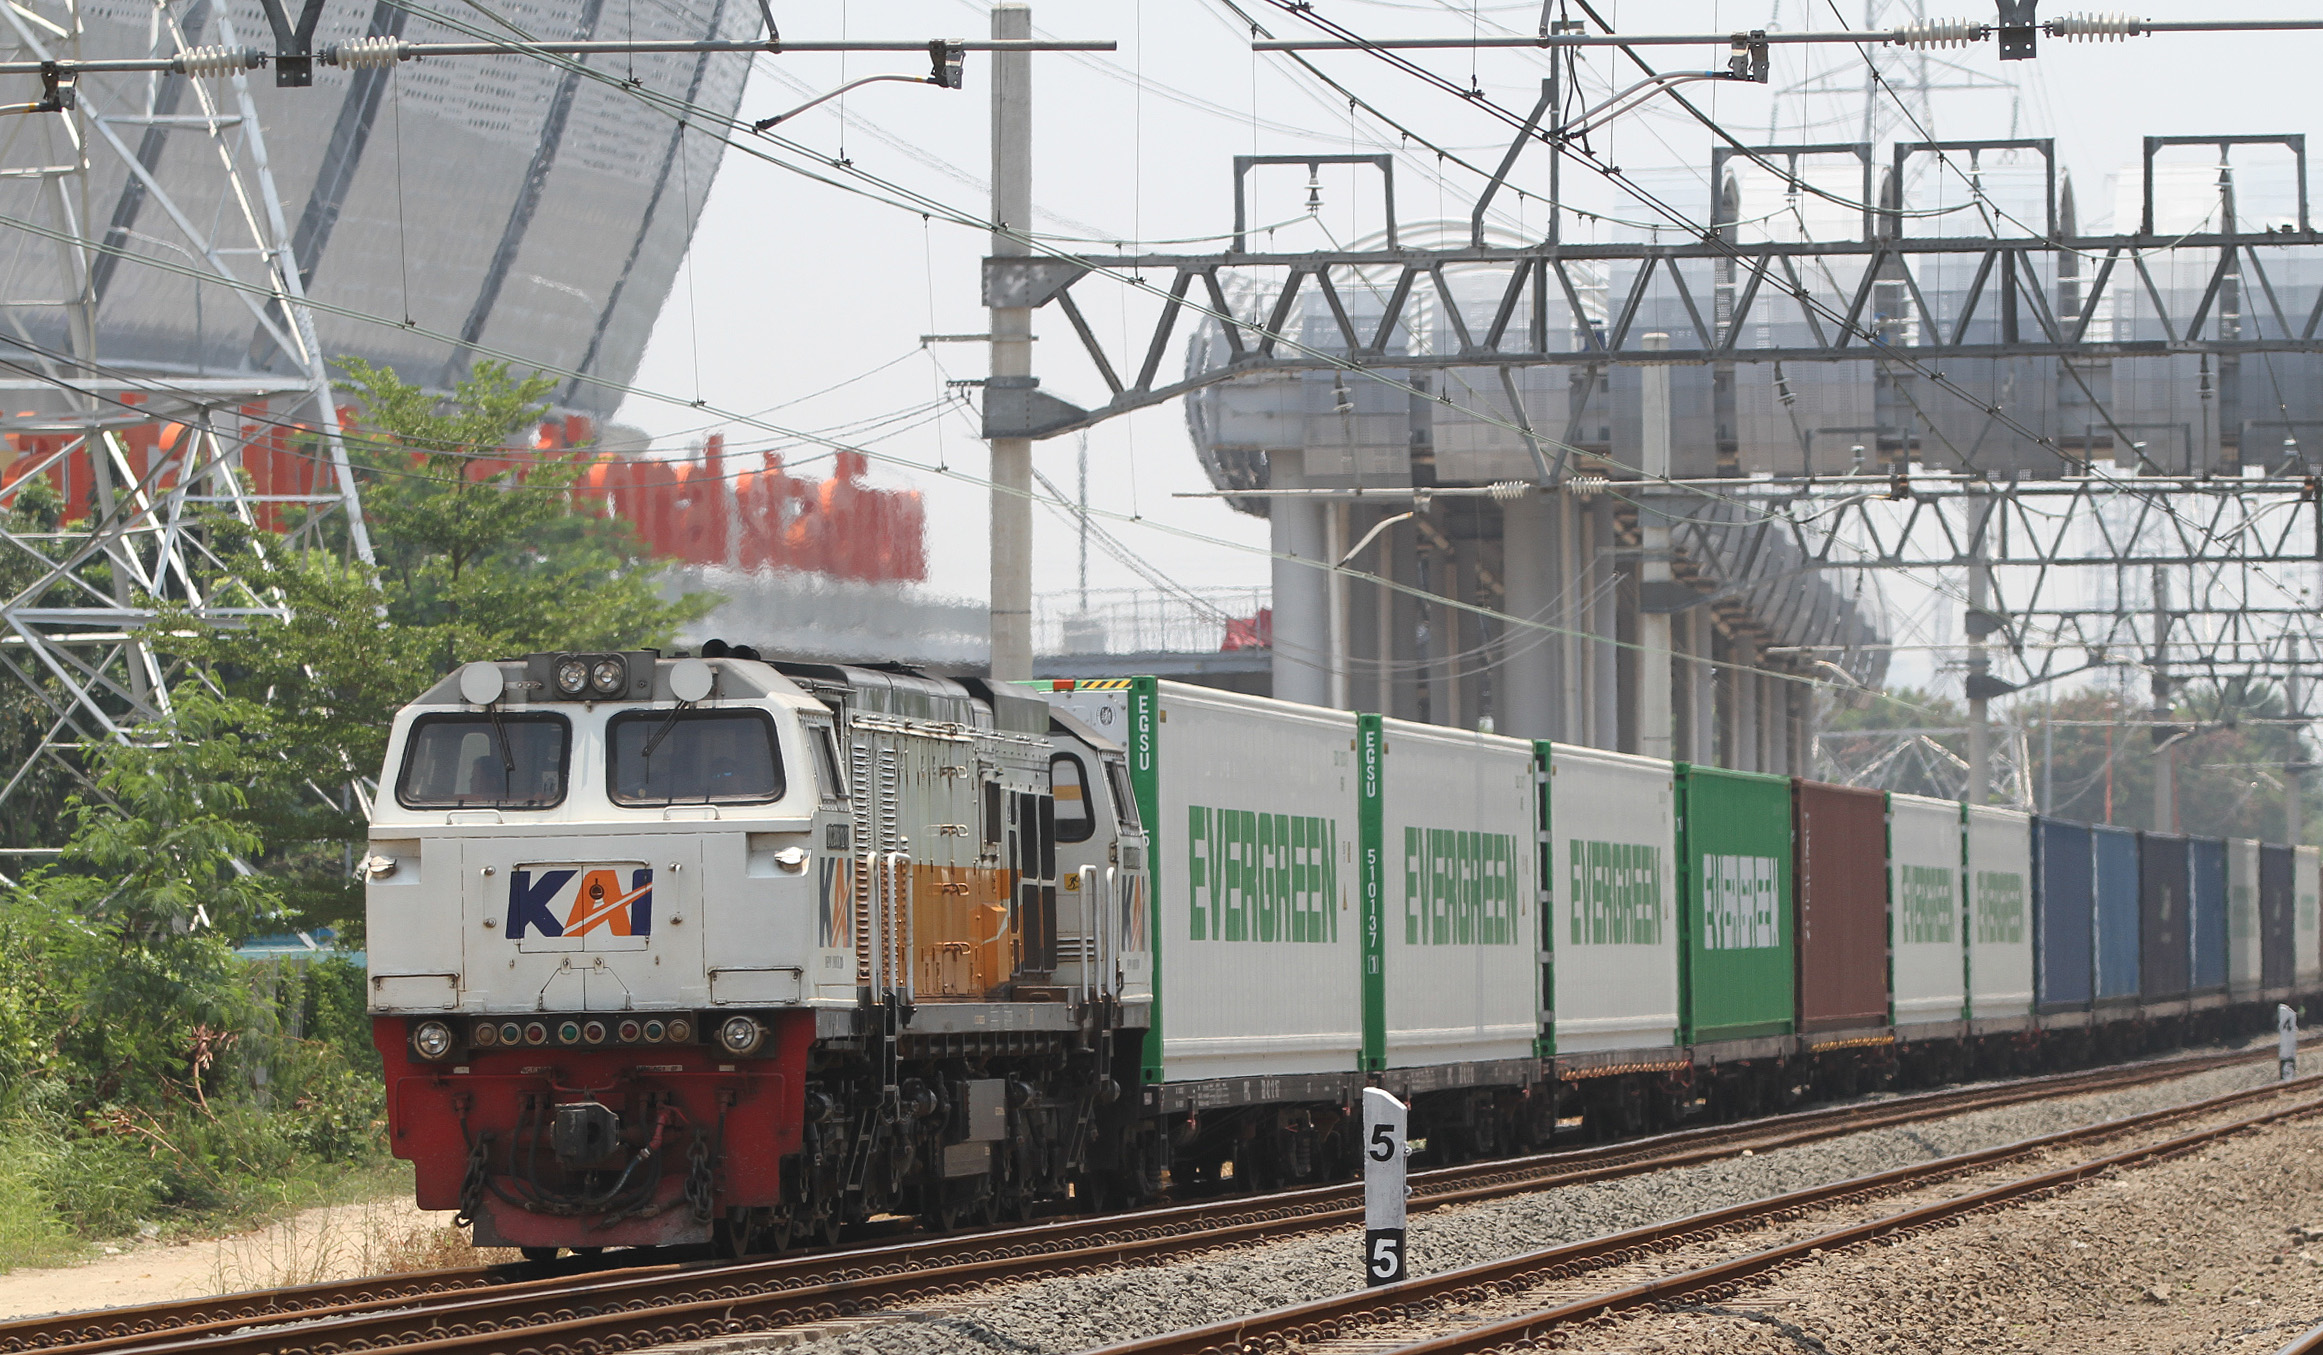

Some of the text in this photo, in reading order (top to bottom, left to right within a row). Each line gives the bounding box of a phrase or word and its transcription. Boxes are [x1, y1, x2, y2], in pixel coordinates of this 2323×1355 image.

[1138, 695, 1150, 771] EGSU
[1189, 805, 1337, 943] EVERGREEN
[1365, 731, 1378, 973] EGSU 510137 1
[1405, 826, 1518, 945] EVERGREEN
[1570, 839, 1662, 945] EVERGREEN
[505, 869, 653, 939] KAI
[819, 857, 852, 948] KAI
[1121, 874, 1146, 953] KAI
[1703, 853, 1779, 949] EVERGREEN
[1369, 1123, 1395, 1162] 5
[1371, 1238, 1398, 1278] 5
